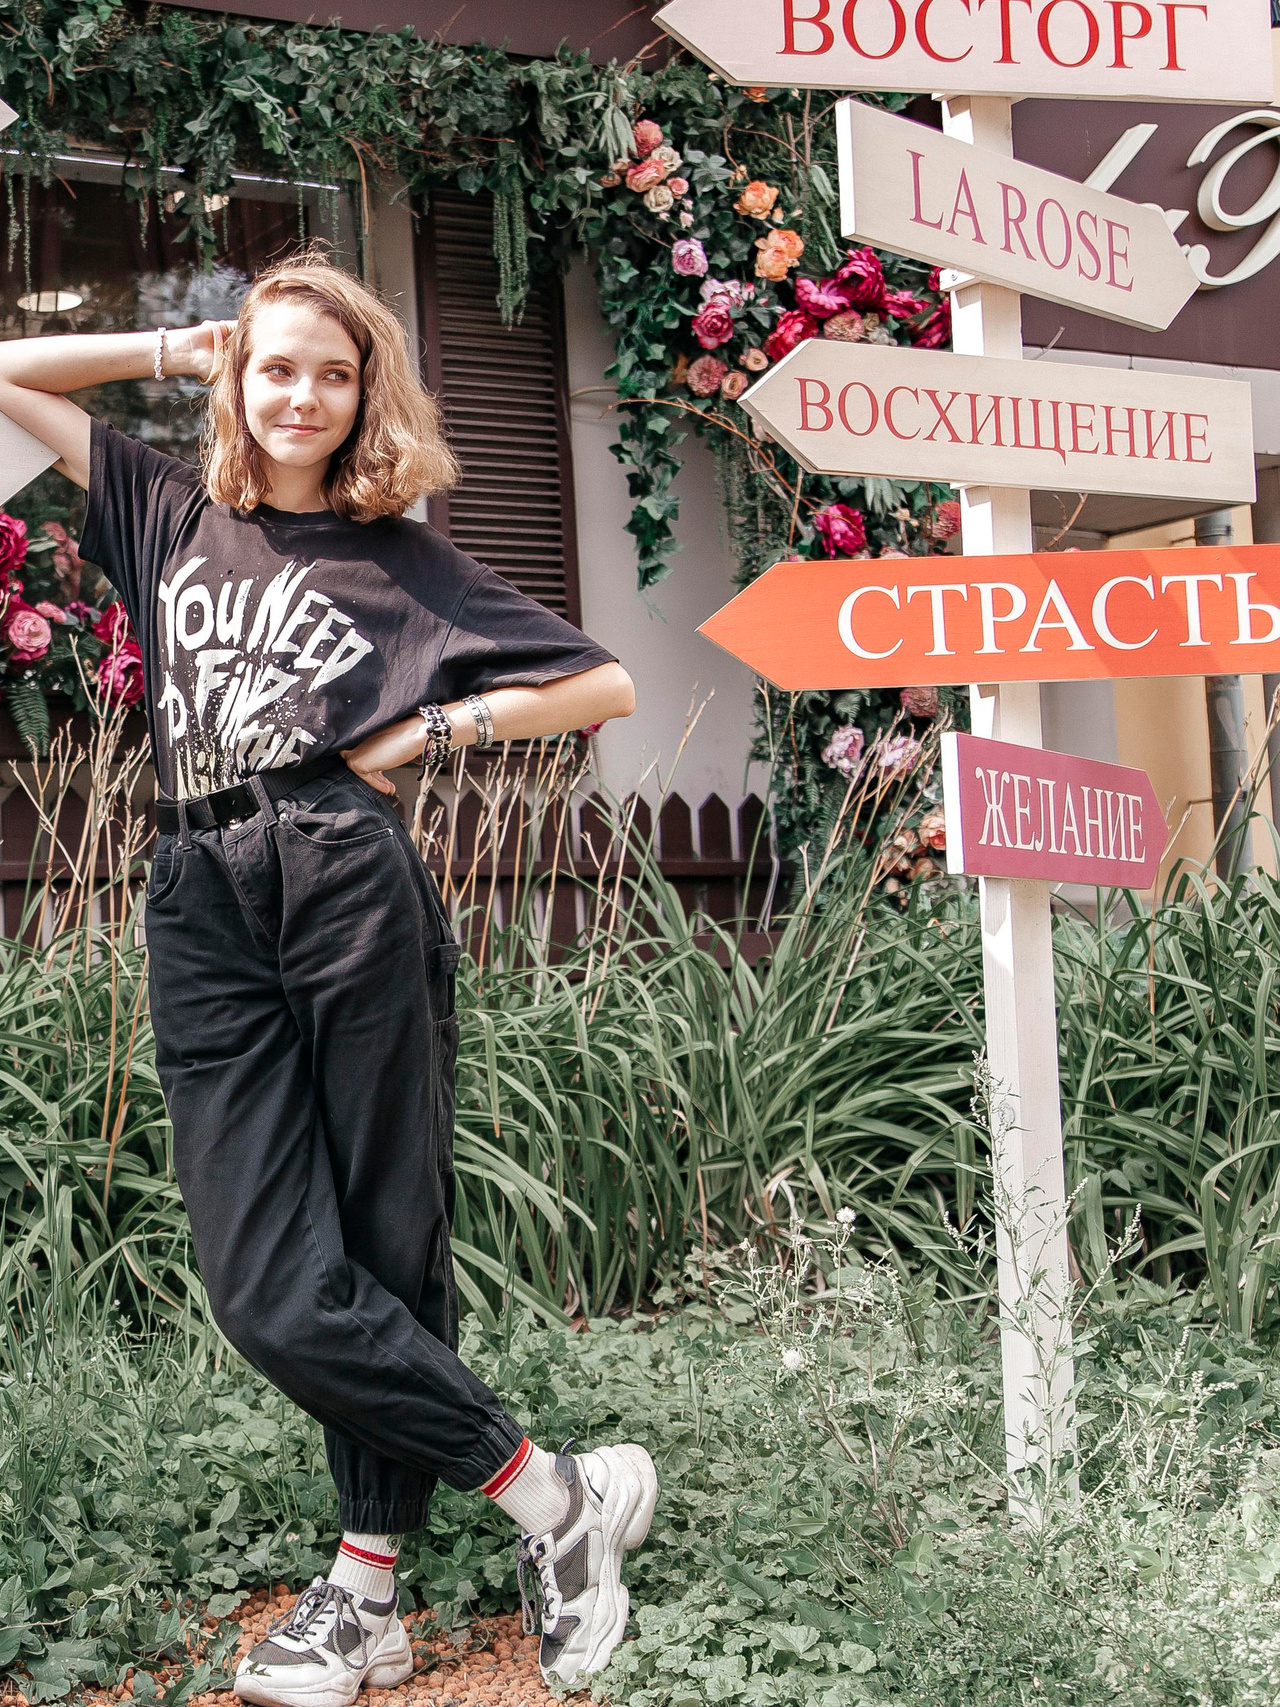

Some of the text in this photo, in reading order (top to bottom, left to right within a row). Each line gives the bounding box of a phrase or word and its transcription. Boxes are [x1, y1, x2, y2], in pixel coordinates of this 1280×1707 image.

[776, 0, 1208, 71] ВОСТОРГ
[906, 149, 988, 246] LA
[996, 181, 1136, 293] ROSE
[794, 377, 1213, 466] ВОСХИЩЕНИЕ
[158, 555, 374, 693] YOU NEED
[837, 572, 1280, 660] СТРАСТЬ
[975, 768, 1147, 865] ЖЕЛАНИЕ
